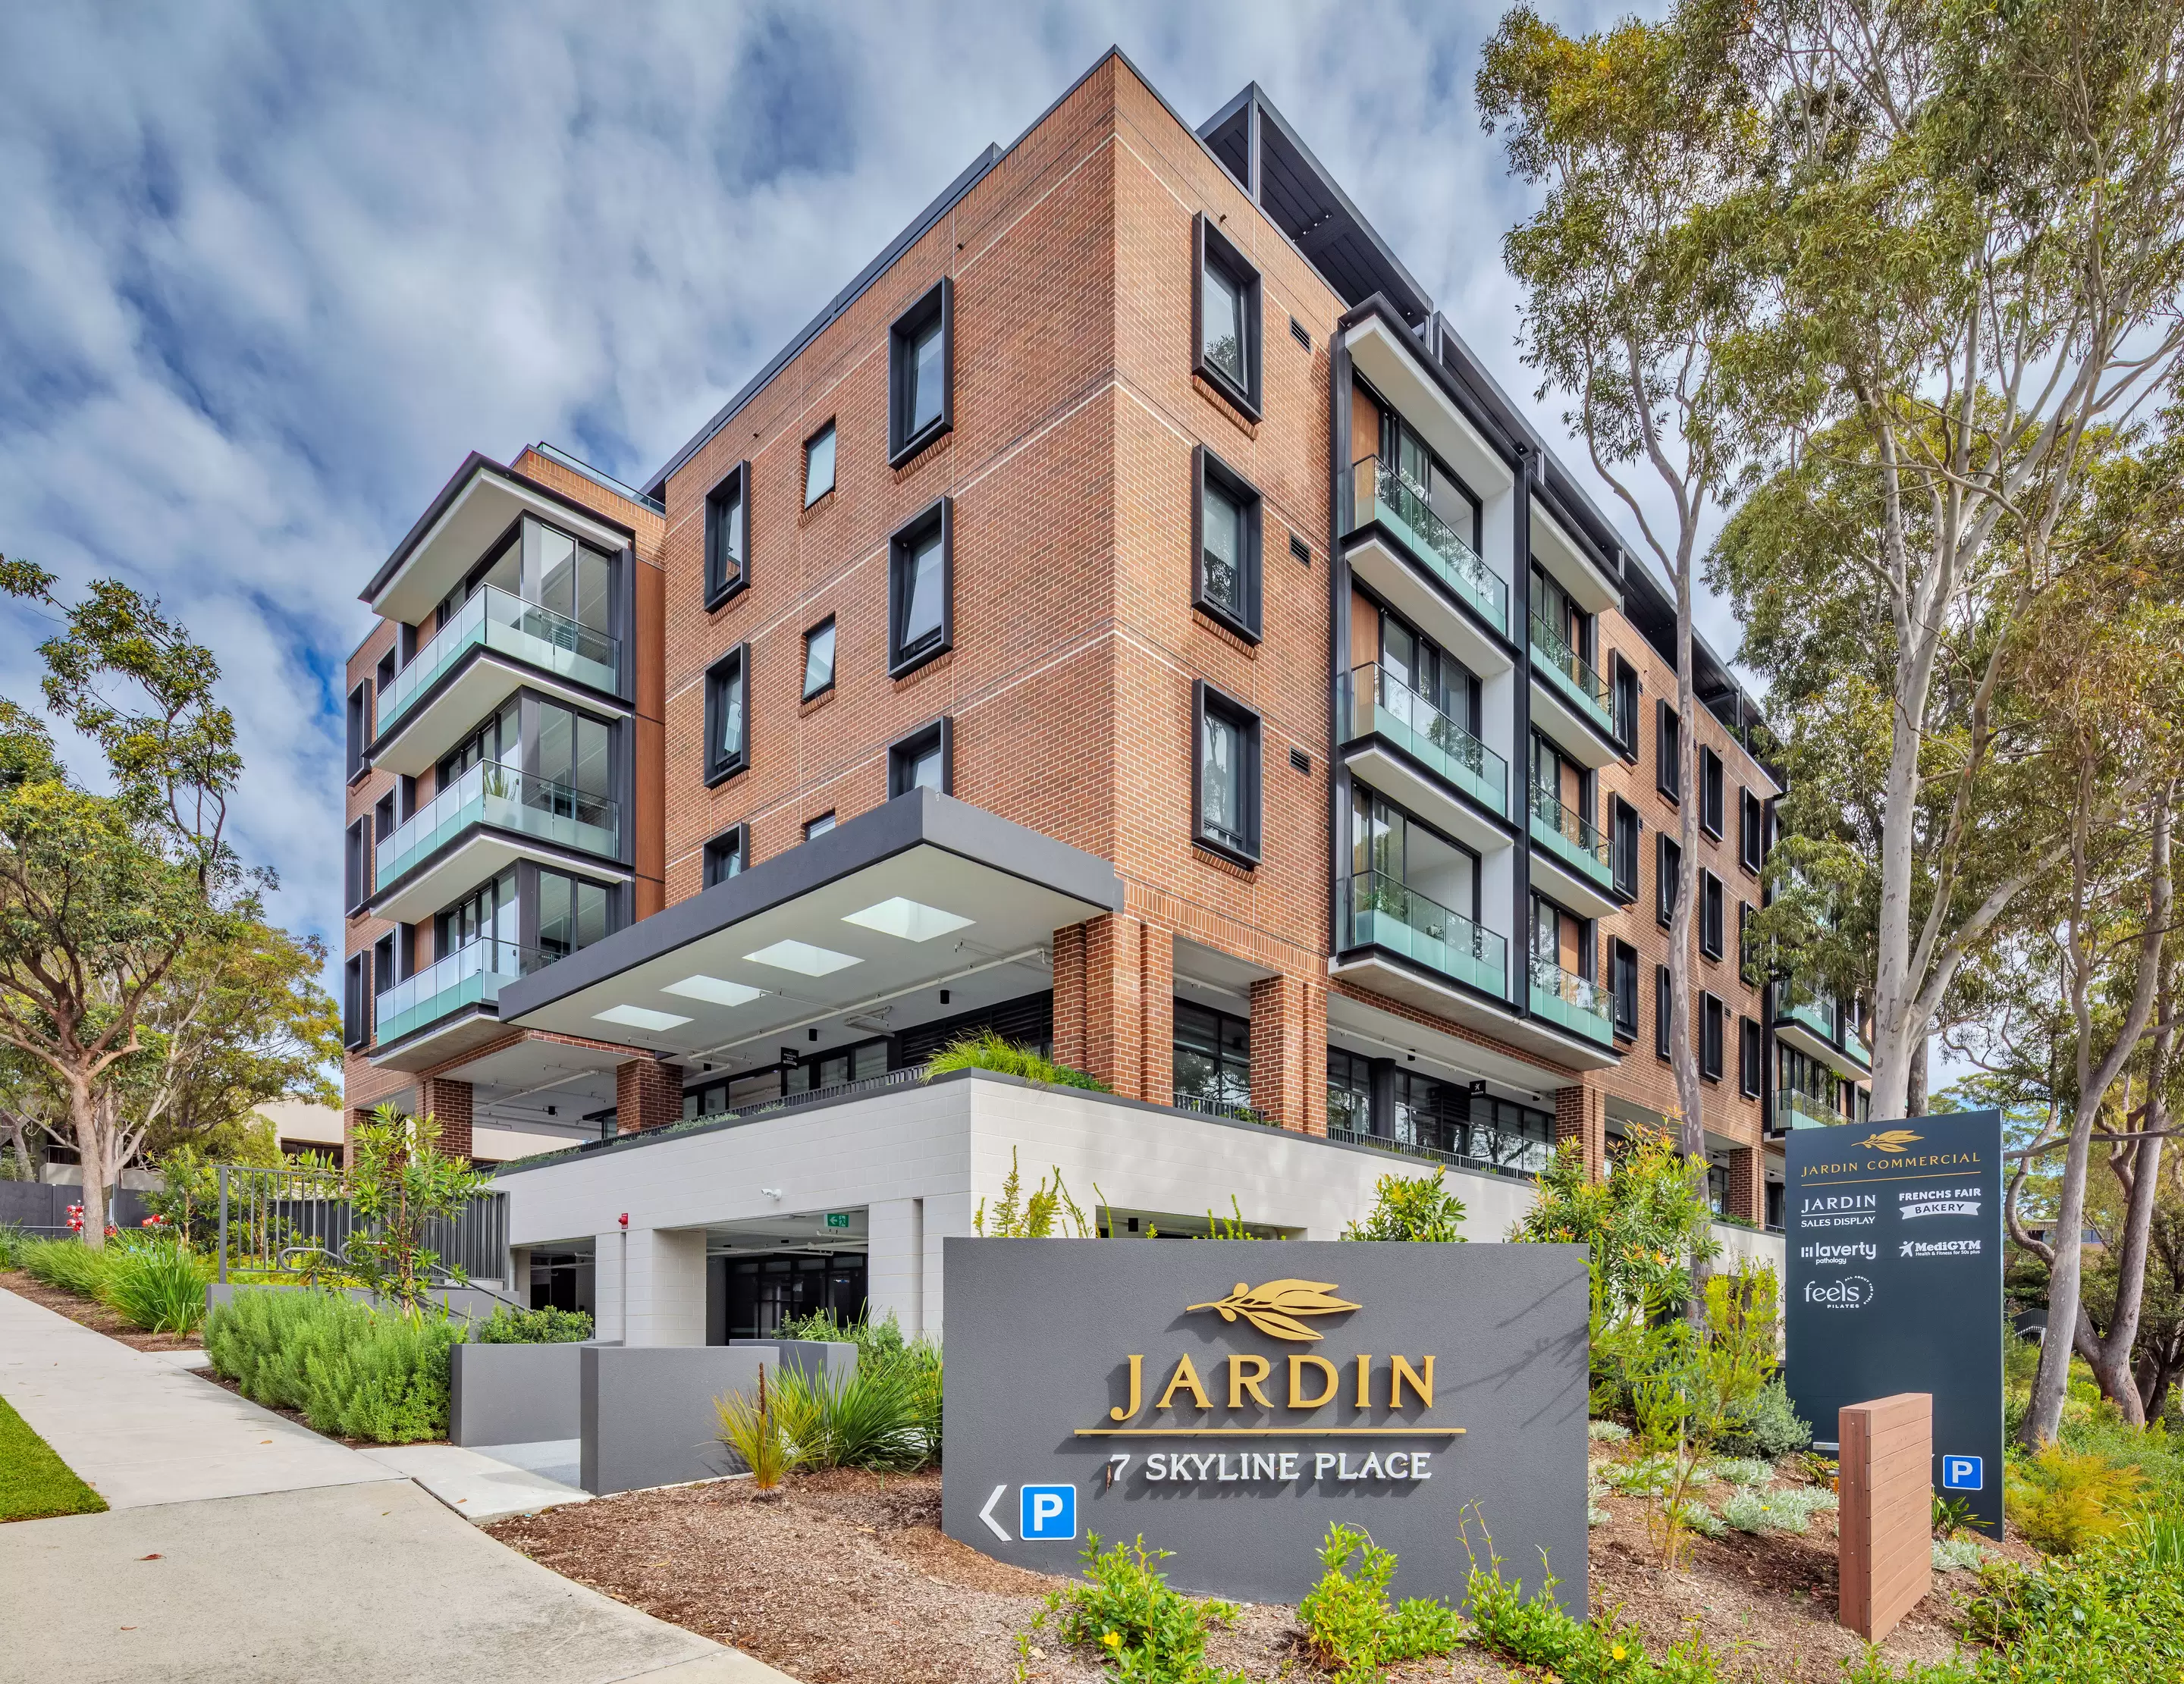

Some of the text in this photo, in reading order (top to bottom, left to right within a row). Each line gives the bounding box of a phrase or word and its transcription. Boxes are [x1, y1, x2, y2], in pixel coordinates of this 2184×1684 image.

[1801, 1152, 1981, 1178] JARDIN COMMERCIAL
[1801, 1194, 1876, 1213] JARDIN
[1899, 1187, 1982, 1201] FRENCHS FAIR
[1915, 1203, 1965, 1214] BAKERY
[1801, 1216, 1875, 1228] SALES DISPLAY
[1815, 1241, 1876, 1260] laverty
[1915, 1240, 1982, 1252] MediGYM
[1815, 1257, 1847, 1265] pathology
[1803, 1280, 1859, 1303] feels
[1109, 1352, 1436, 1422] JARDIN
[1109, 1452, 1432, 1482] 7 SKYLINE PLACE
[1952, 1460, 1973, 1484] P
[1033, 1493, 1064, 1532] P
